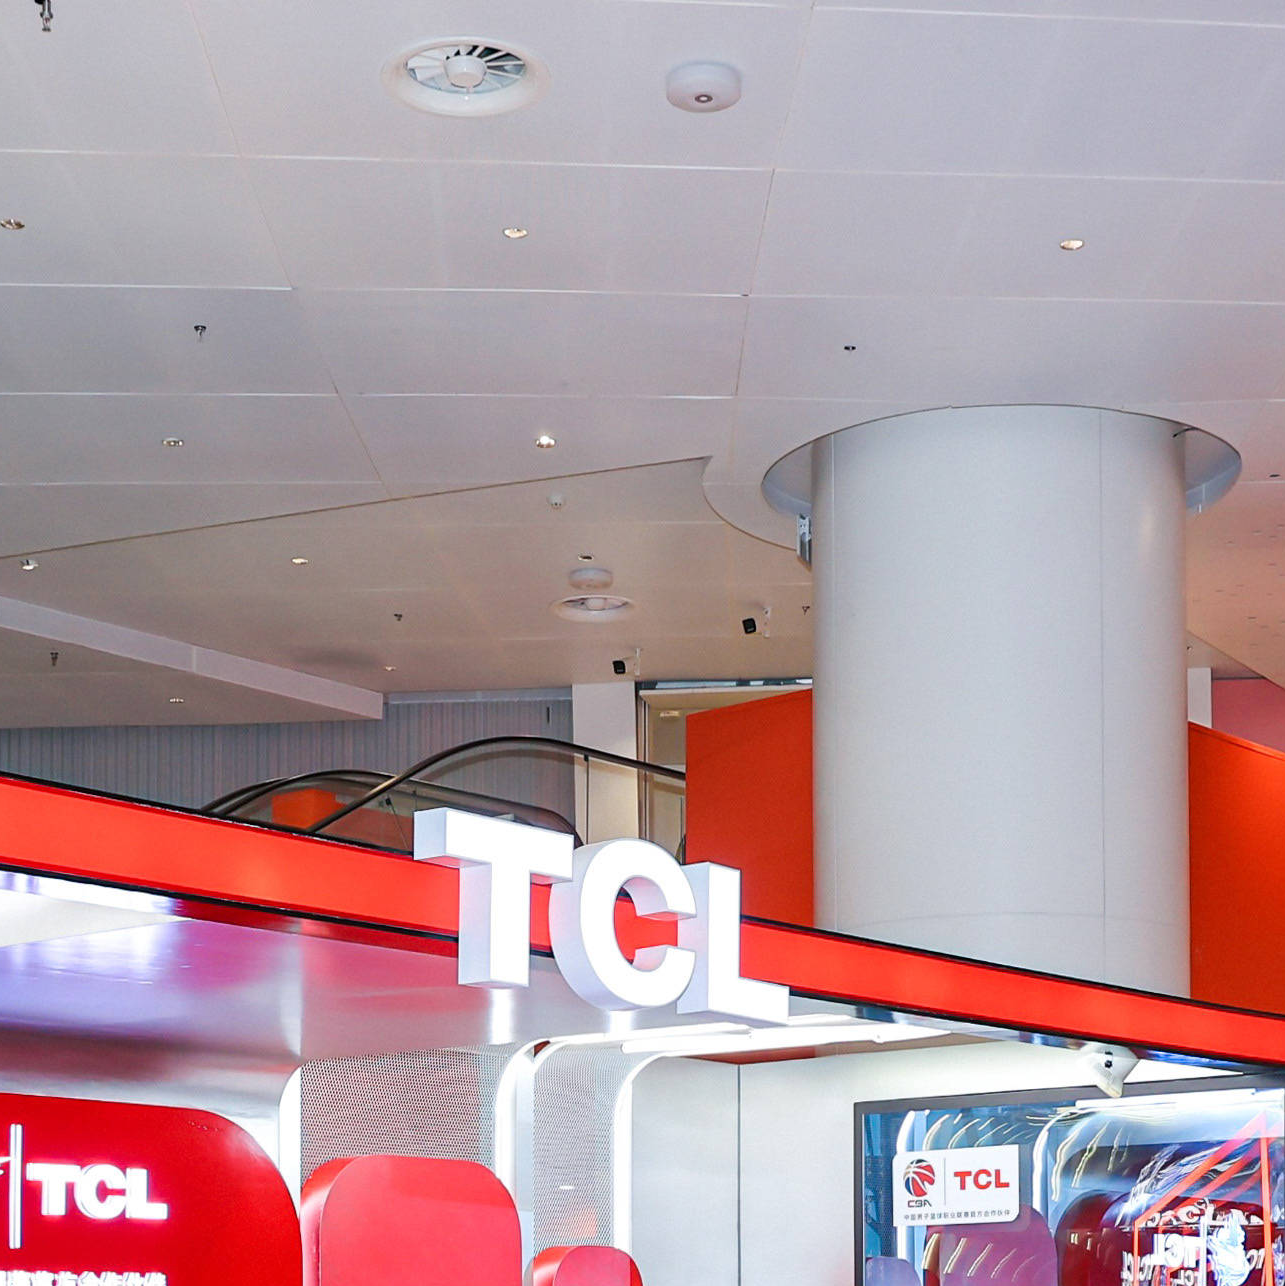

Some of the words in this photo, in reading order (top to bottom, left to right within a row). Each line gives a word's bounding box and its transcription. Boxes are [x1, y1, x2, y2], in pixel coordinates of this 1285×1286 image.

[414, 807, 790, 1025] TCL
[26, 1163, 169, 1220] TCL
[953, 1169, 1010, 1190] TCL
[907, 1199, 932, 1208] CBA
